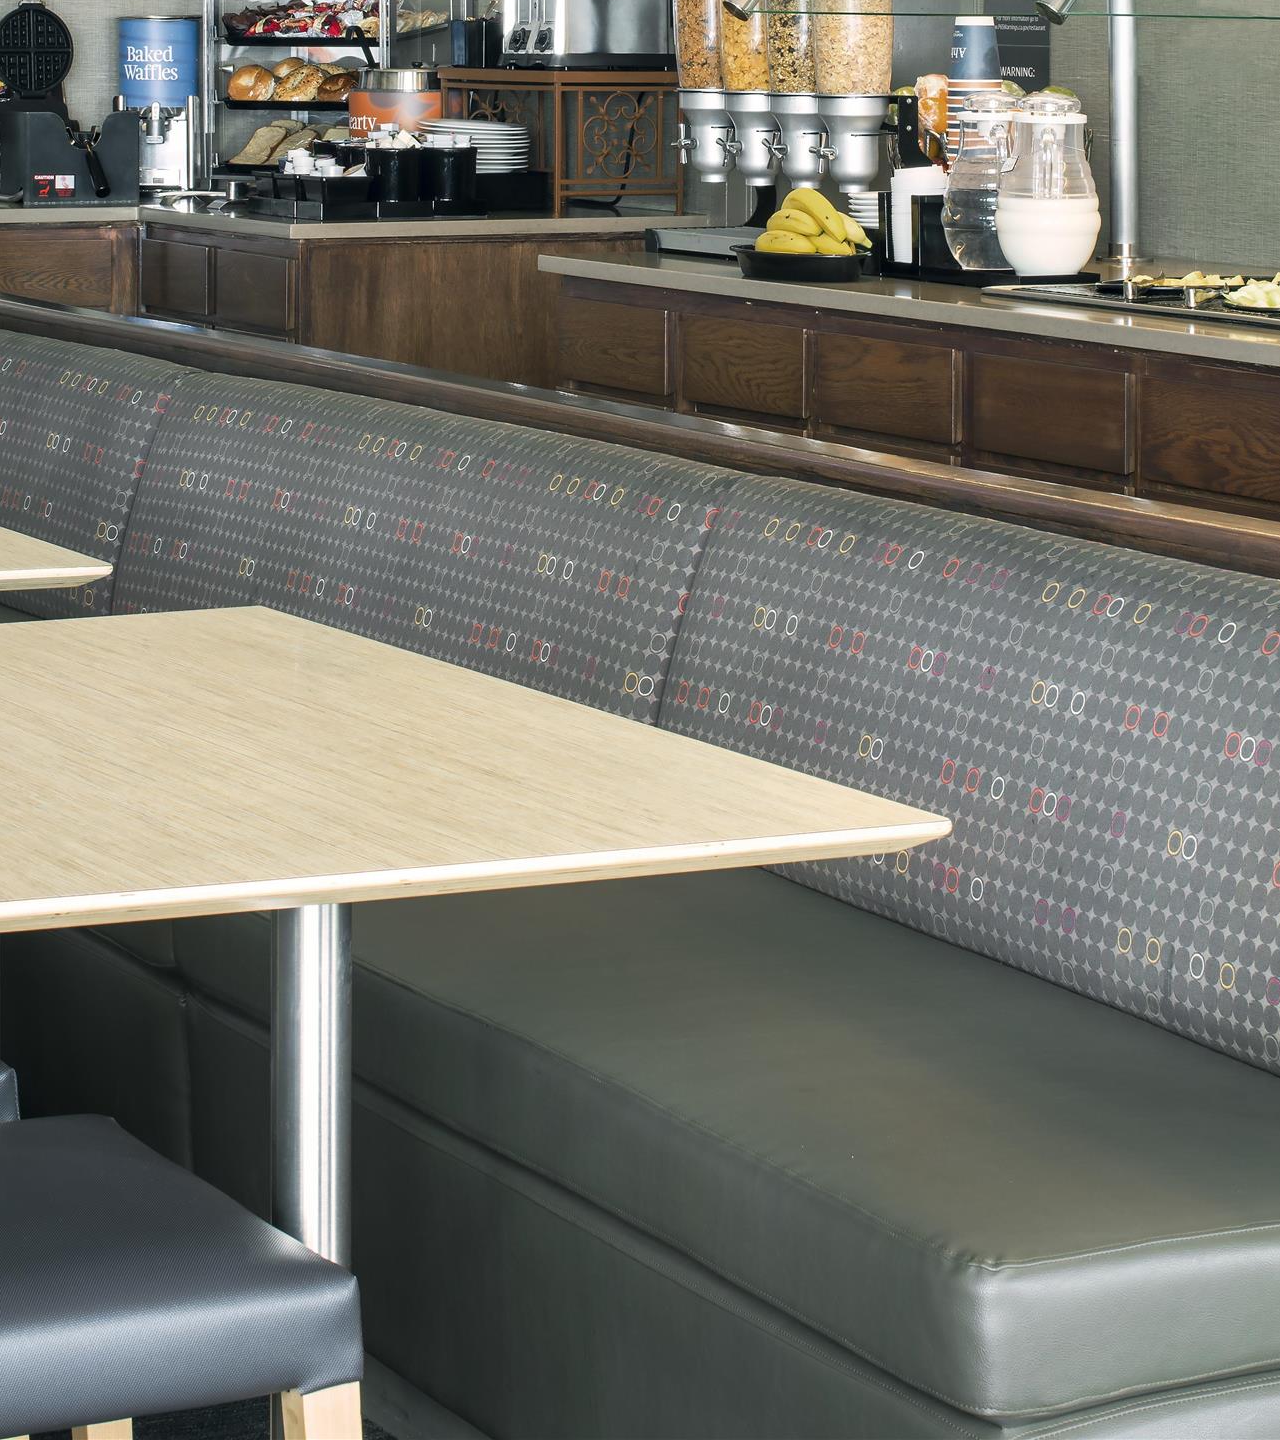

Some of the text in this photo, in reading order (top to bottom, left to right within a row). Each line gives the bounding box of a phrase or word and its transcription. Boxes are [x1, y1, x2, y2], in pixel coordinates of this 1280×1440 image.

[126, 46, 174, 62] Baked
[124, 64, 179, 81] Waffles
[1000, 66, 1036, 78] WARNING:
[349, 115, 377, 131] earty
